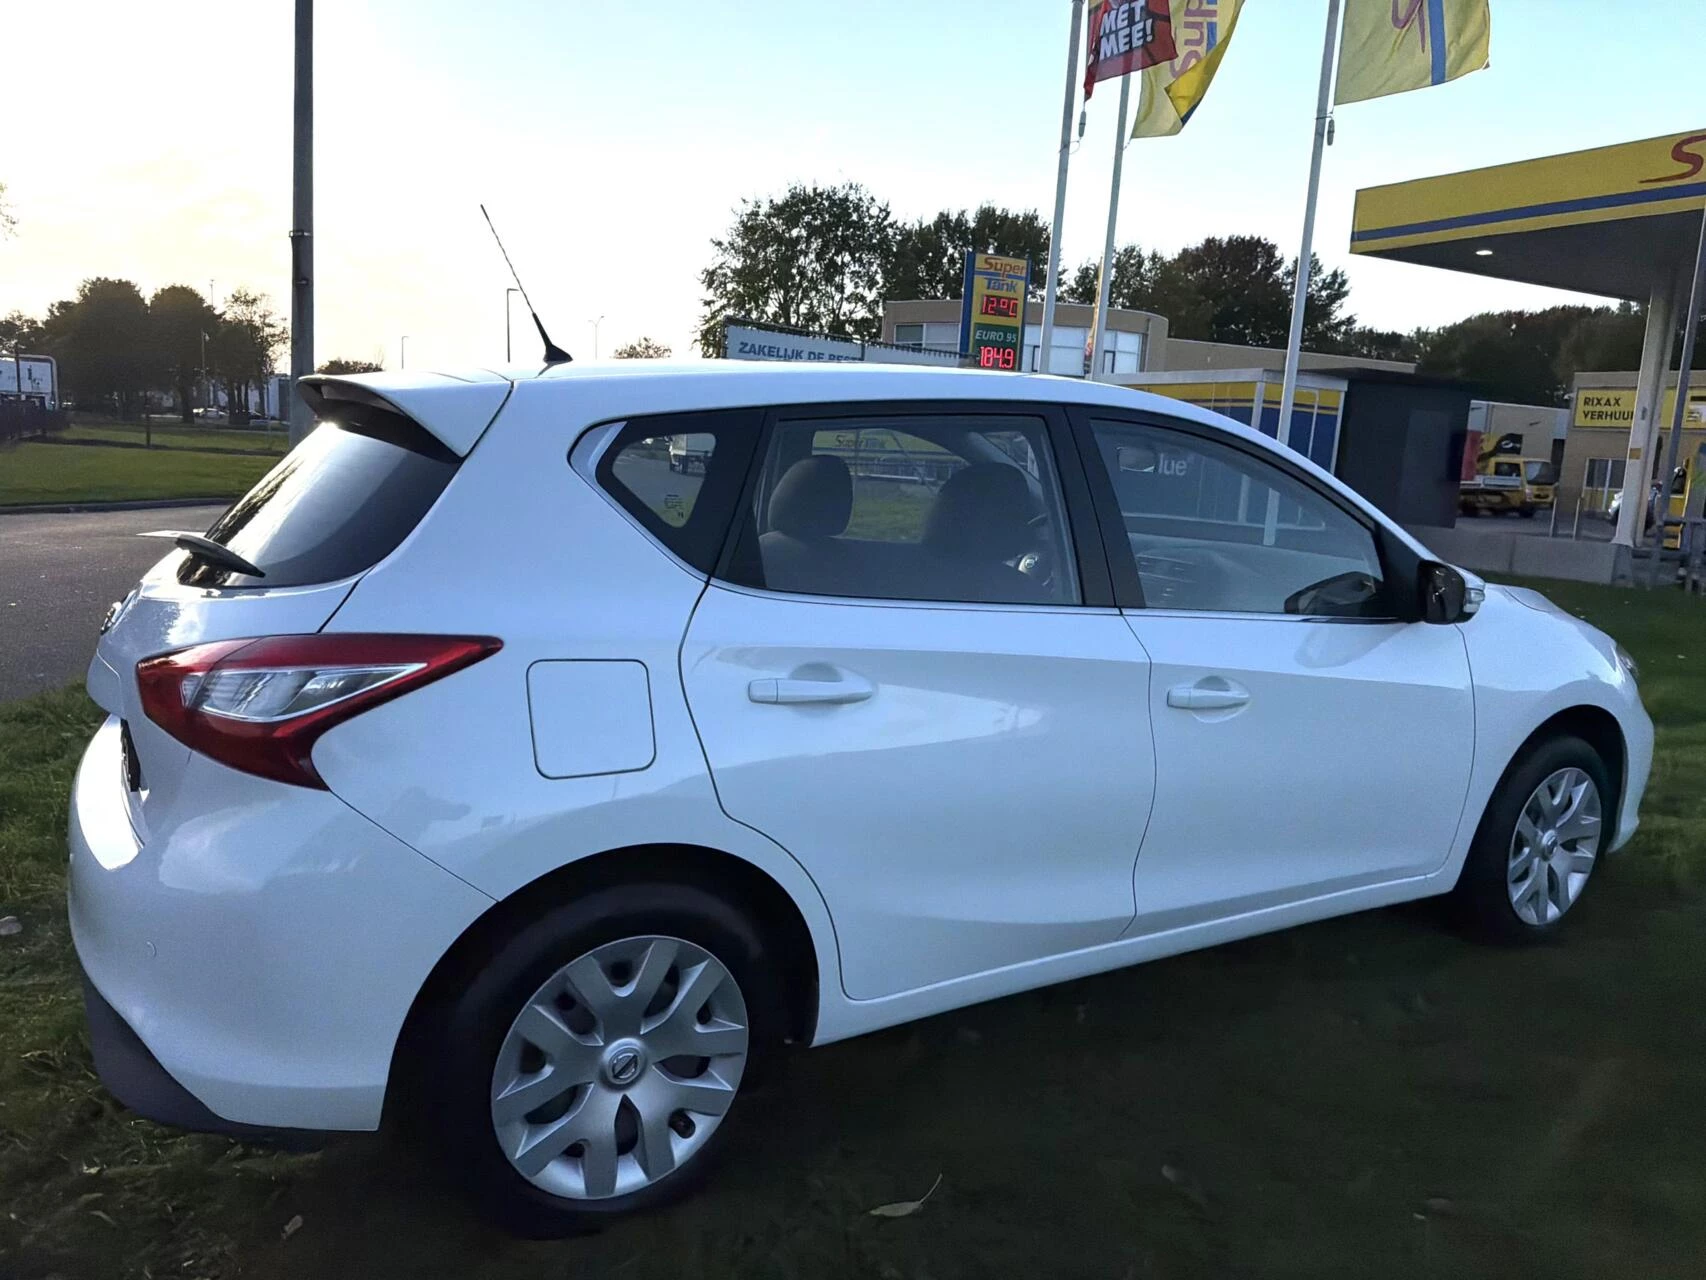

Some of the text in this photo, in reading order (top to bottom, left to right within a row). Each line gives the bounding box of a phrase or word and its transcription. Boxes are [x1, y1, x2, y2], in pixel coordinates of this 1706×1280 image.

[1101, 0, 1145, 36] MET
[1100, 18, 1153, 60] MEE!
[976, 257, 1026, 280] Super
[984, 277, 1018, 292] Tank
[975, 329, 1017, 343] EURO 95
[738, 342, 804, 359] ZAKELIJK
[1583, 396, 1621, 407] RIXAX
